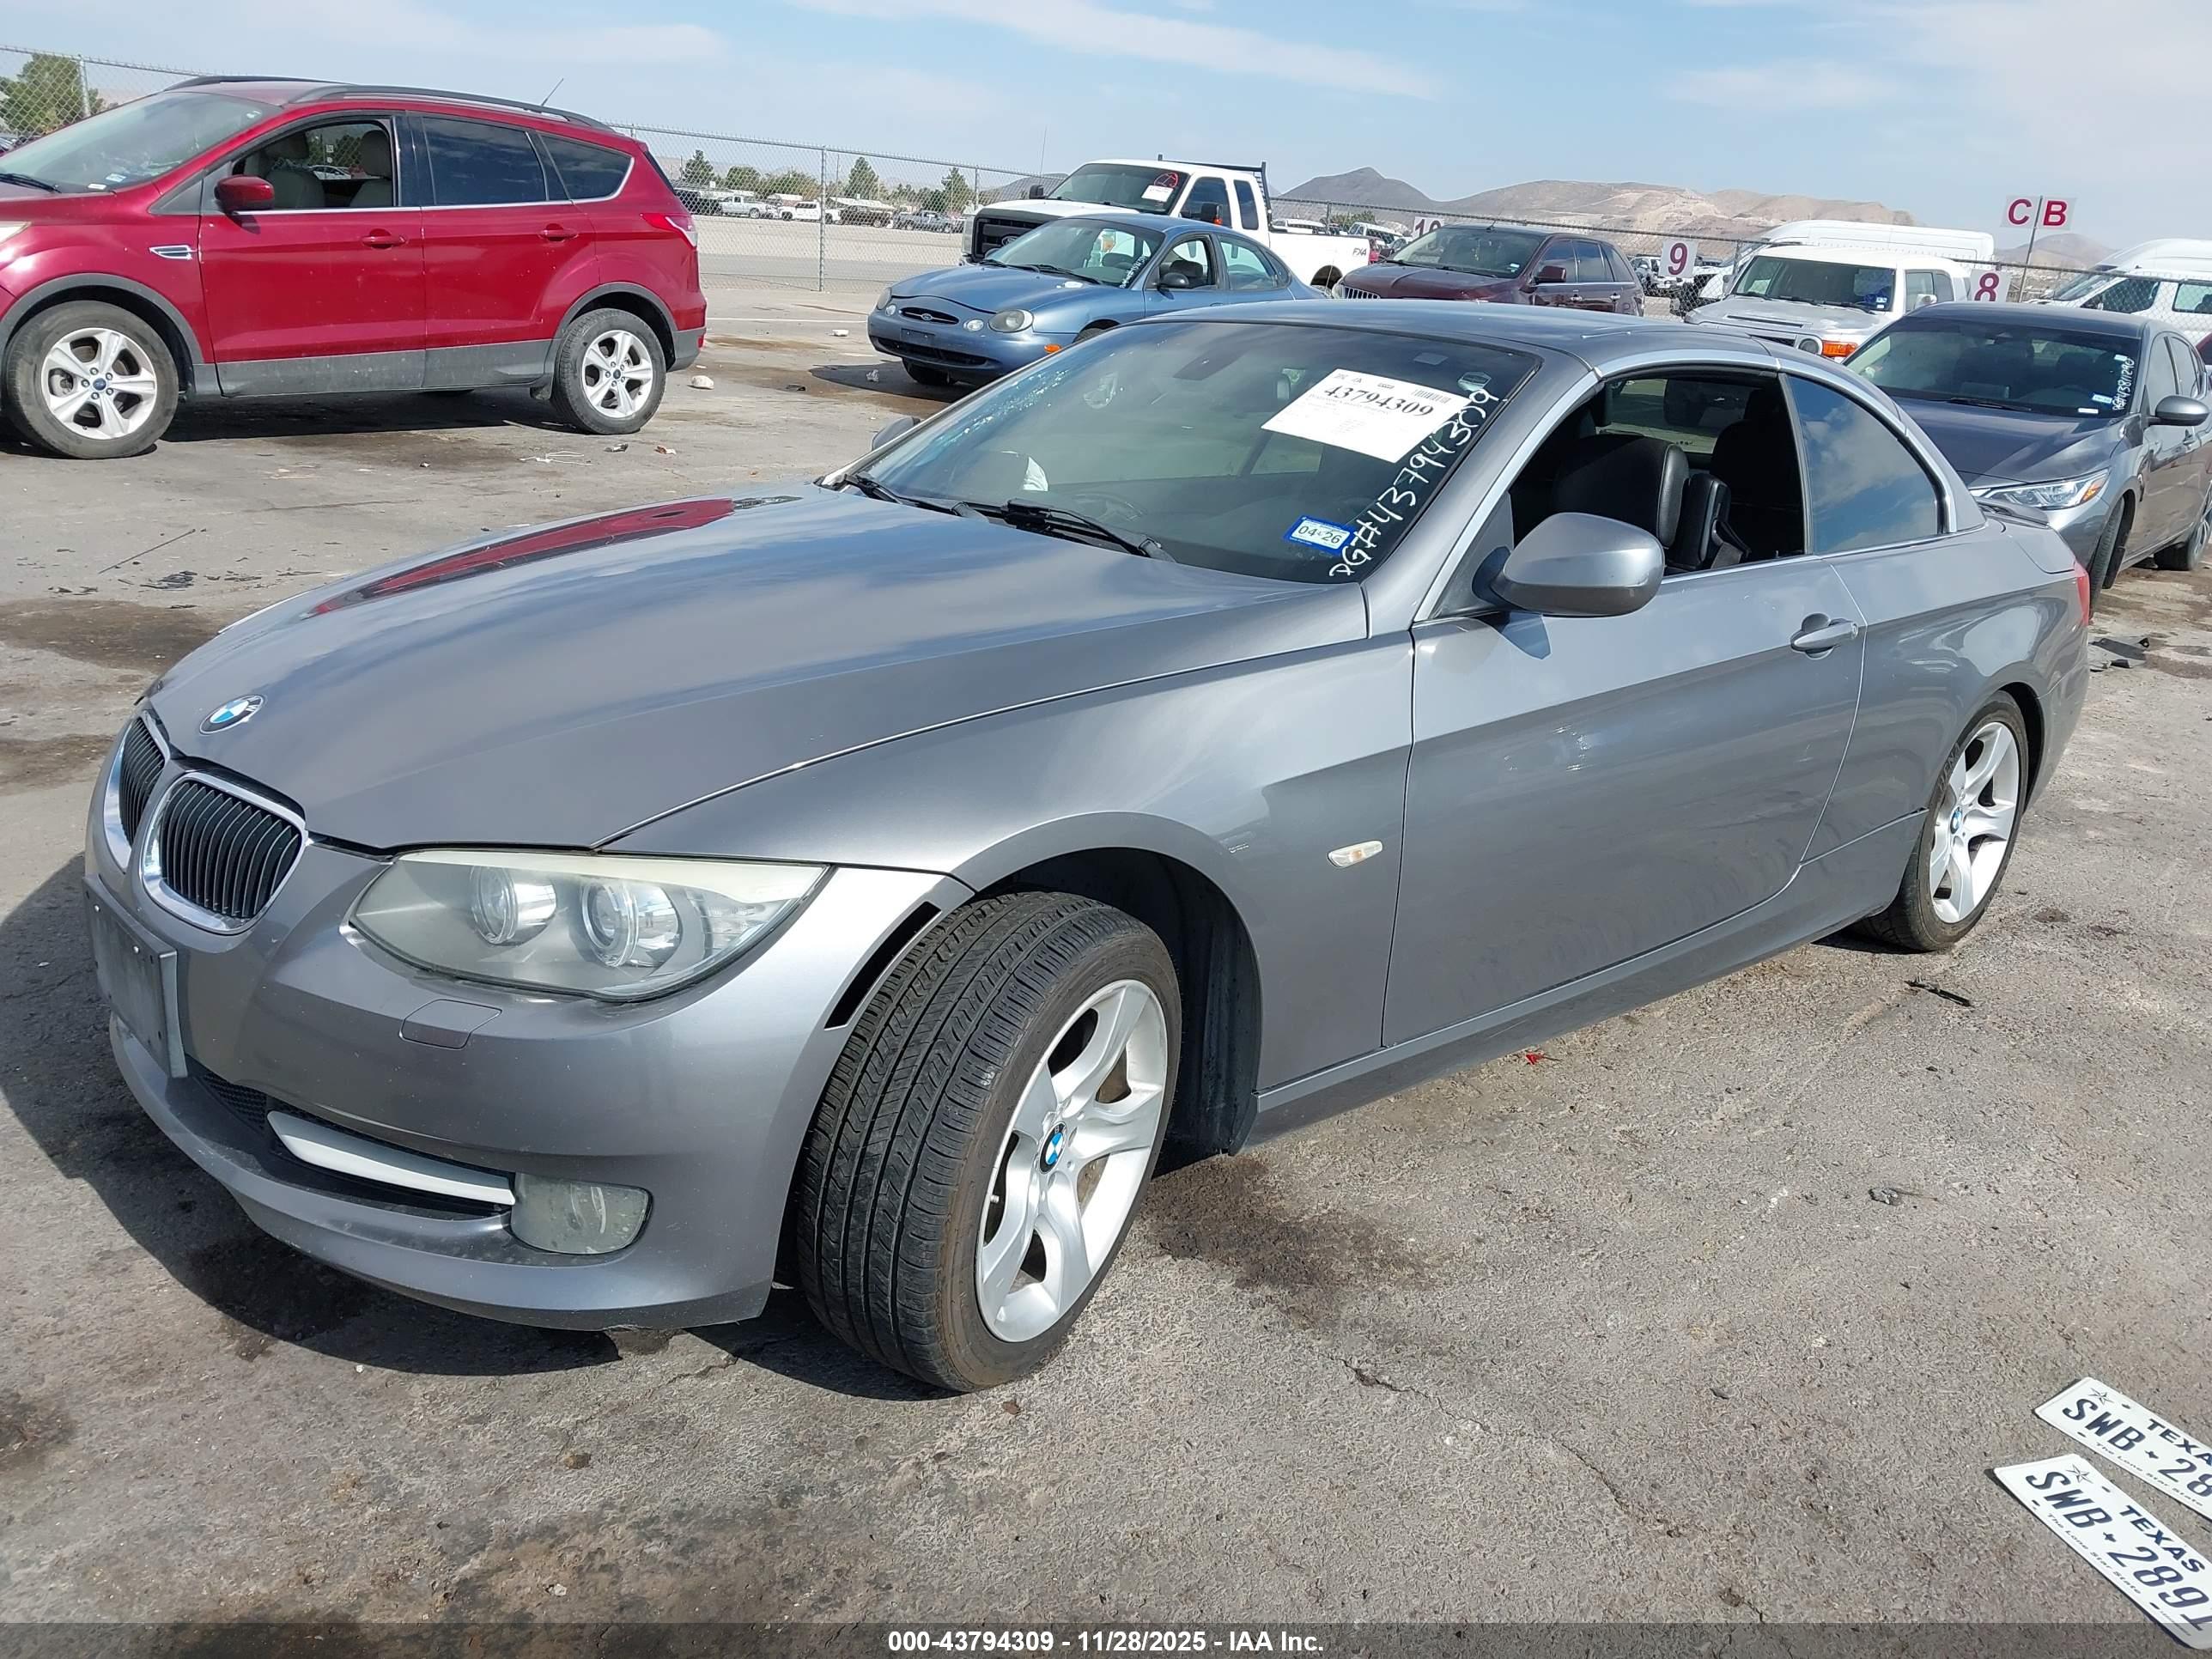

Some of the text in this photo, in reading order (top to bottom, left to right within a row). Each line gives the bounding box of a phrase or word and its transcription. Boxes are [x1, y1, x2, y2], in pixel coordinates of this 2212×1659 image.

[2008, 198, 2033, 225] C
[2043, 200, 2068, 226] B
[1668, 242, 1688, 276] 9
[1974, 272, 2000, 301] 8
[1323, 385, 1435, 417] 43794309
[1297, 526, 1317, 537] 04
[1321, 532, 1343, 544] 26
[2062, 1398, 2146, 1451] SWB
[2025, 1471, 2112, 1528] SWB
[2119, 1504, 2206, 1573] TEXAS
